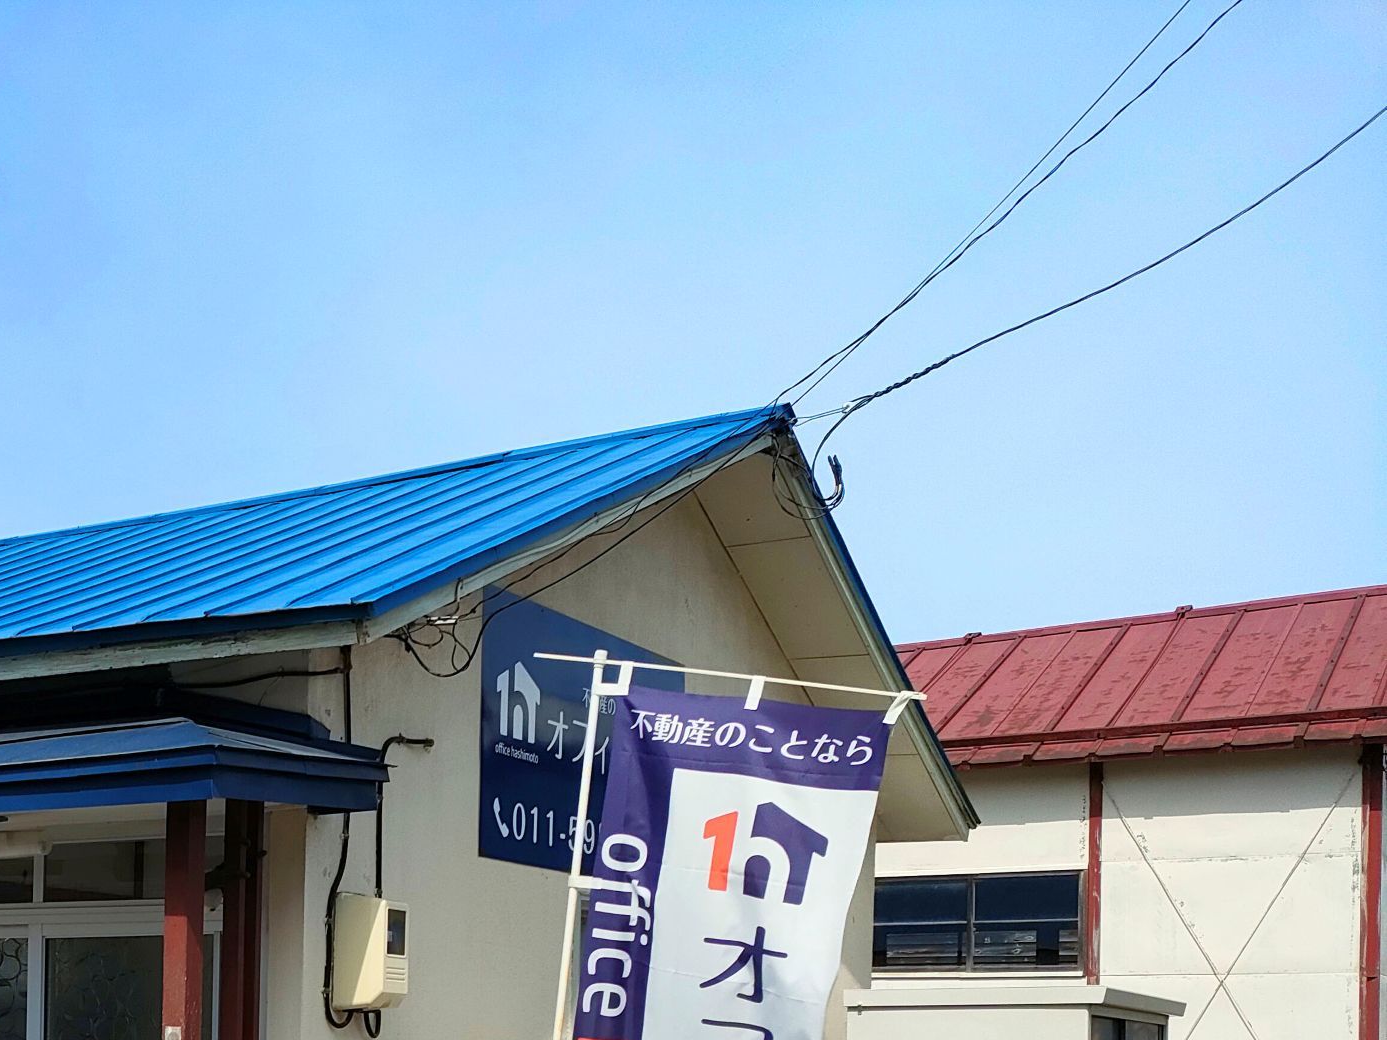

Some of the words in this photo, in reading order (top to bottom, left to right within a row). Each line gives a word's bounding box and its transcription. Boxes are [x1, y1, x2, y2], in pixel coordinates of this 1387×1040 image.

[494, 743, 511, 757] office
[511, 745, 539, 764] hashimoto
[630, 707, 874, 766] 不動産のことなら
[513, 802, 601, 855] 011-59
[581, 834, 652, 1017] office
